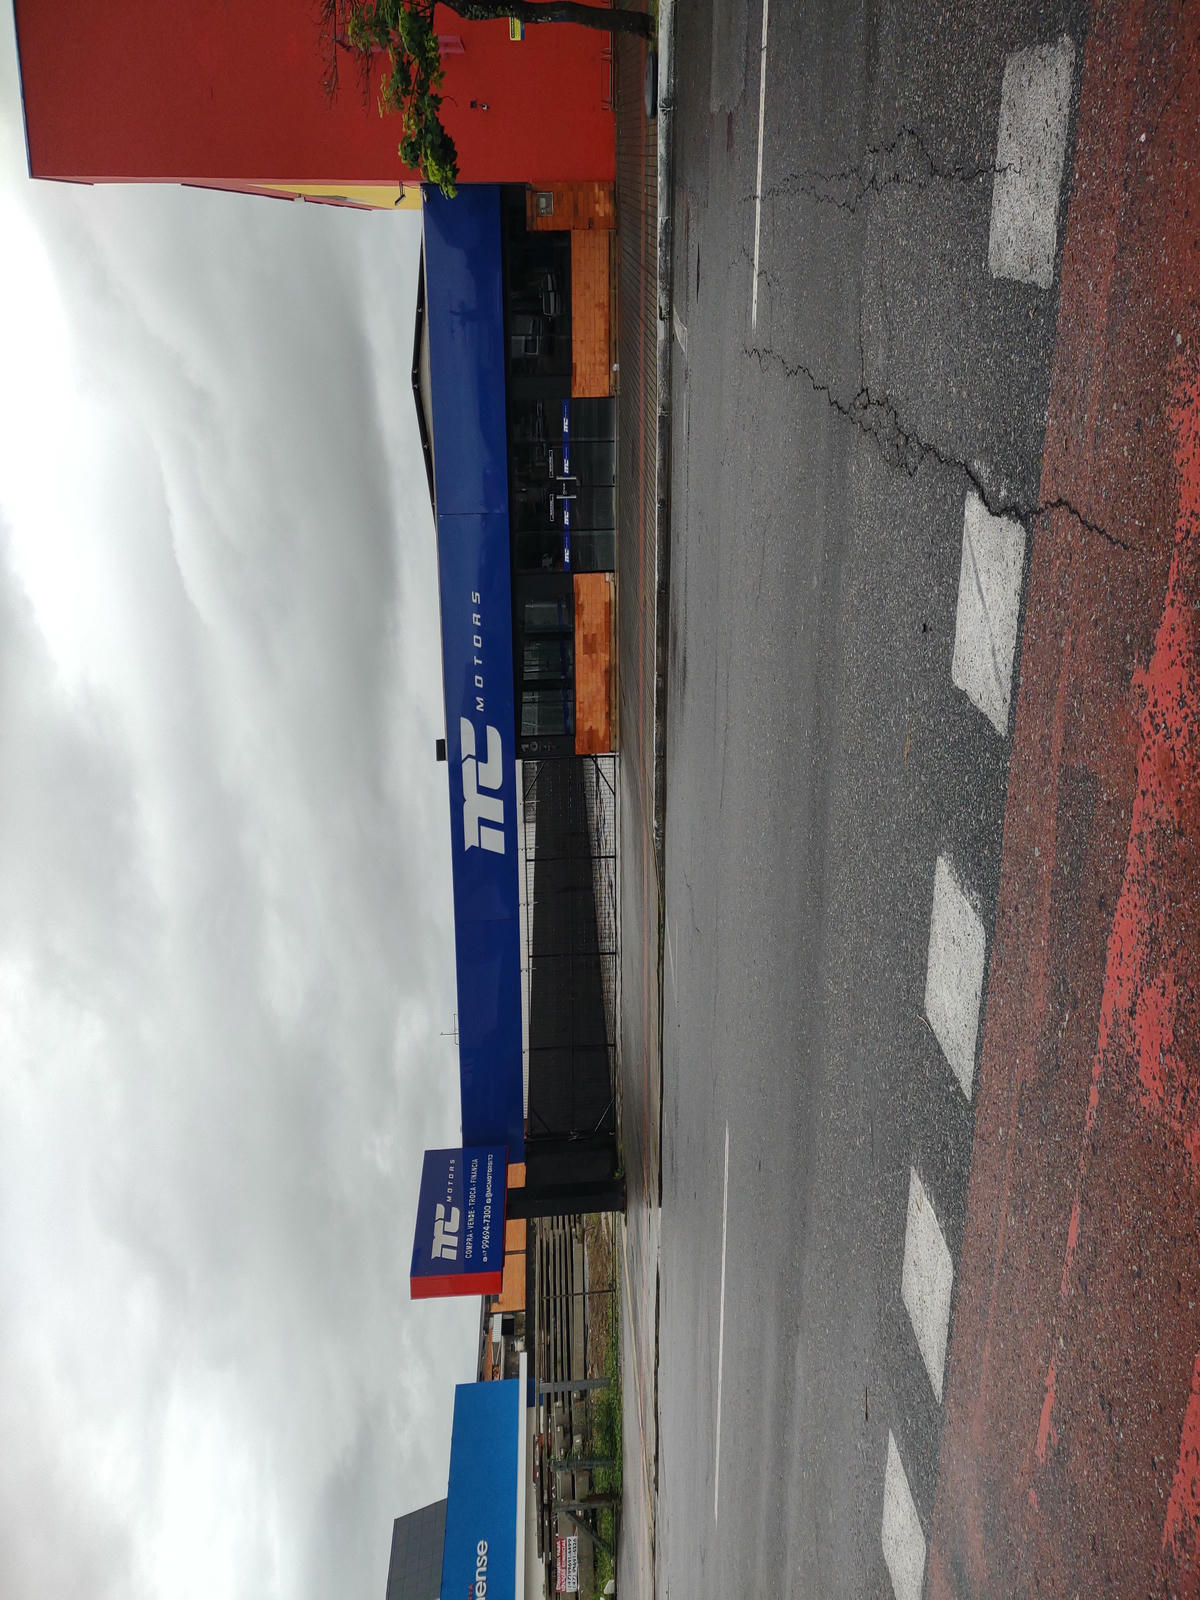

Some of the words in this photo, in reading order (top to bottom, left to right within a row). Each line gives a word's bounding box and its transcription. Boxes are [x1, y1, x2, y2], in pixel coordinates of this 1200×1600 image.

[472, 591, 484, 712] MOTORS
[460, 717, 505, 855] MC
[470, 1159, 478, 1183] FINANCIA
[431, 1204, 460, 1260] MC
[447, 1159, 455, 1202] MOTORS
[469, 1187, 477, 1206] TROCA
[467, 1210, 475, 1229] VENDE
[482, 1205, 491, 1249] 99694-7300
[465, 1233, 474, 1258] COMPRA
